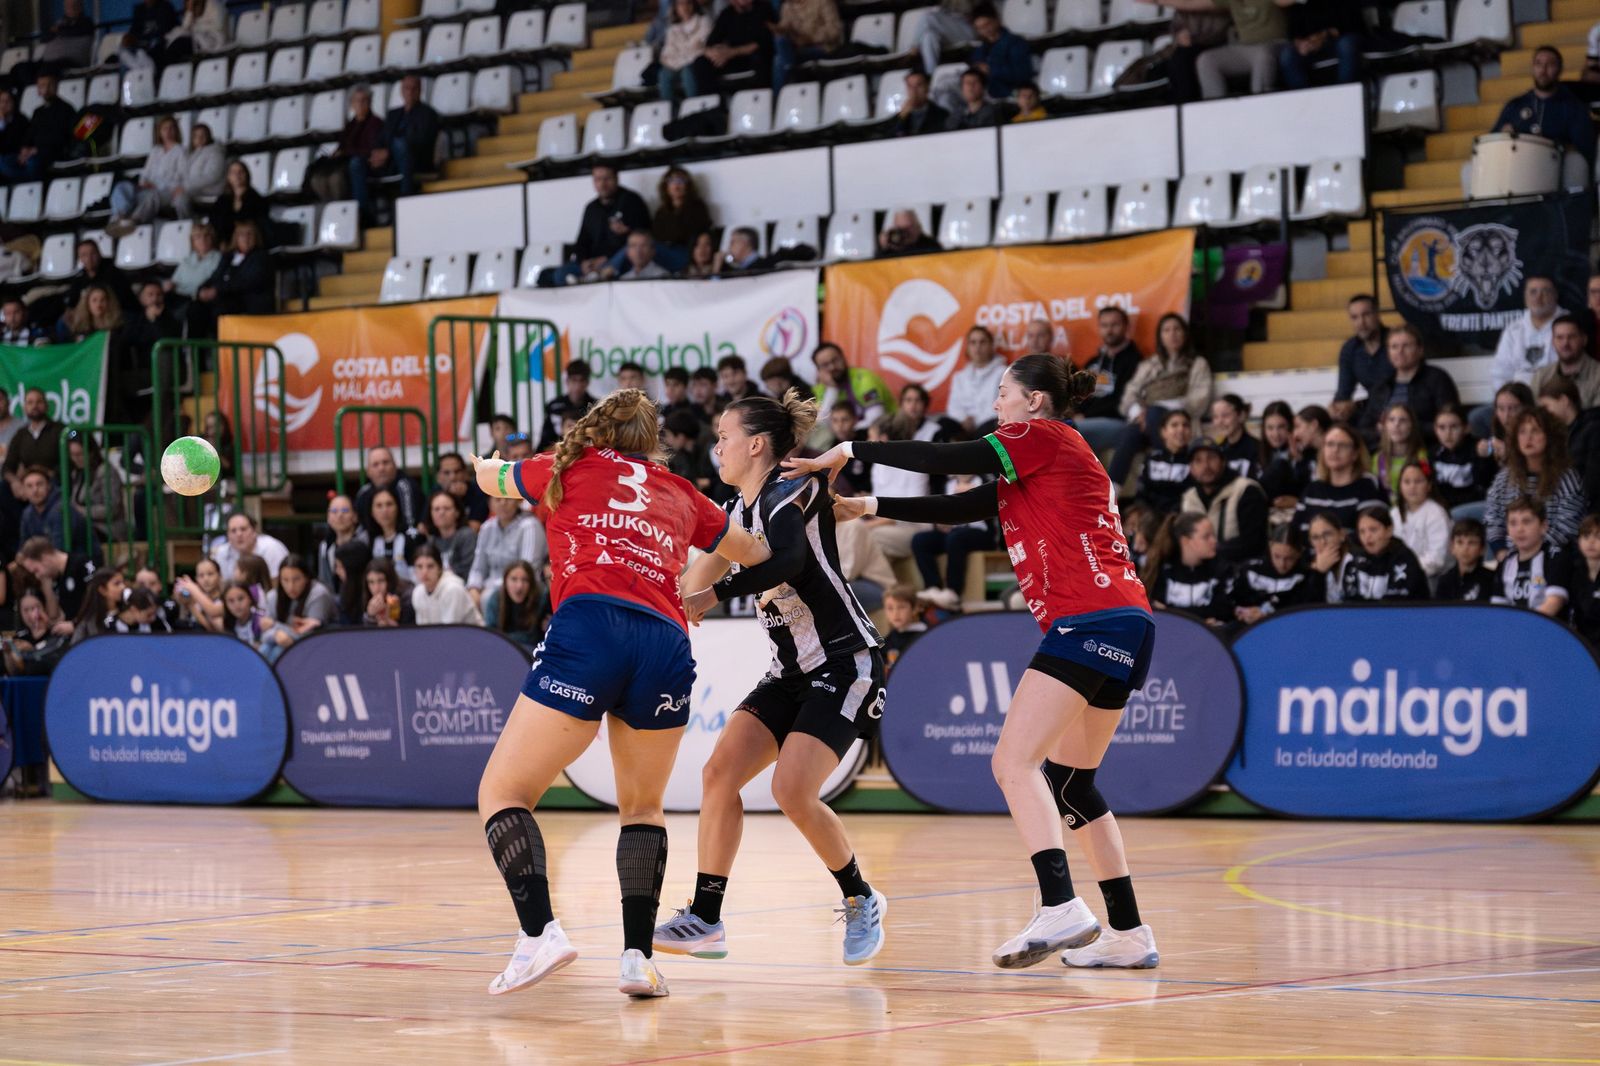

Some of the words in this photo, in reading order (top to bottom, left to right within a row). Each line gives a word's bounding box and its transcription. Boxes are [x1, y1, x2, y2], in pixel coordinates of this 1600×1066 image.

[976, 302, 1050, 326] COSTA
[1052, 298, 1092, 321] DEL
[1094, 293, 1141, 315] SOL
[332, 357, 389, 379] COSTA
[391, 355, 422, 376] DEL
[333, 379, 404, 401] MÁLAGA
[577, 513, 674, 553] ZHUKOVA
[1080, 533, 1100, 572] INDUPOR
[1098, 647, 1135, 668] CASTRO
[415, 682, 497, 709] MÁLAGA
[549, 683, 595, 705] CASTRO
[89, 674, 238, 753] málaga
[1277, 658, 1528, 756] málaga
[411, 708, 504, 735] COMPITE
[924, 723, 984, 741] Diputación
[951, 742, 966, 755] de
[1275, 747, 1292, 767] la
[1295, 748, 1357, 768] ciudad
[1360, 749, 1438, 770] redonda
